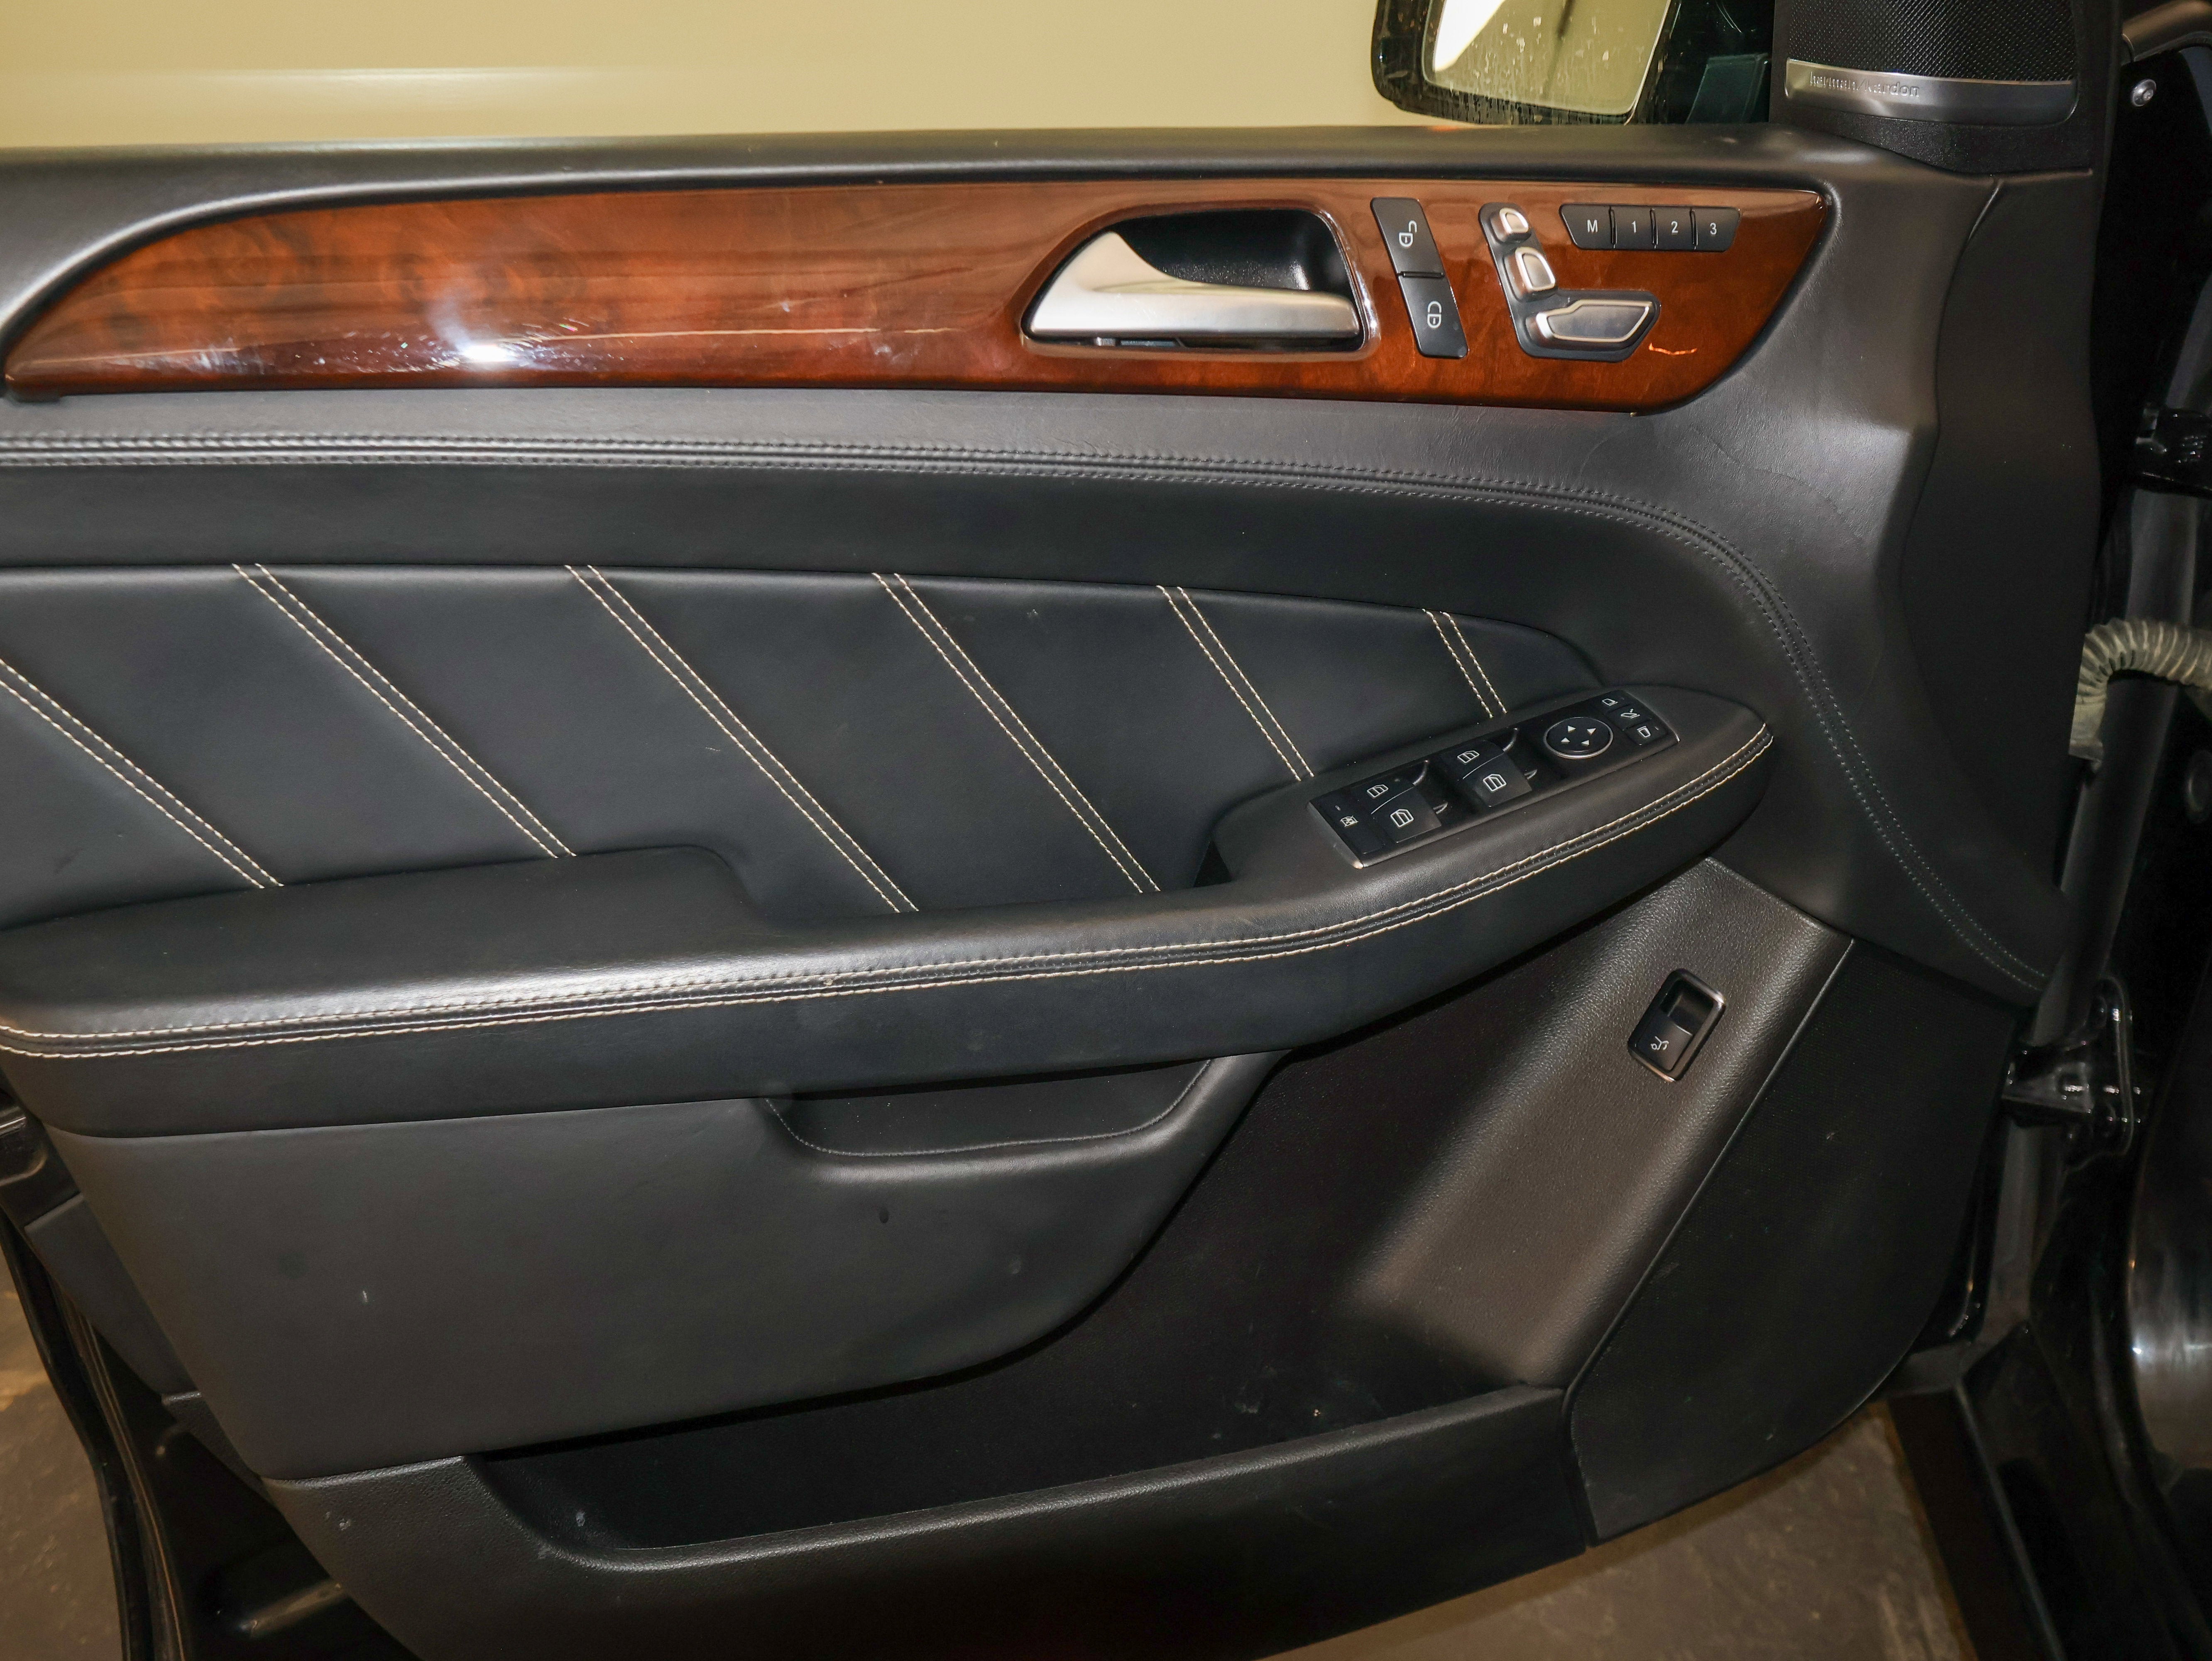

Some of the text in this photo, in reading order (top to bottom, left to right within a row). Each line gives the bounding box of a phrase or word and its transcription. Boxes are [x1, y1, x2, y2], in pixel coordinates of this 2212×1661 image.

[1810, 71, 1920, 98] harman/kardon
[1587, 219, 1717, 235] M 1 2 3
